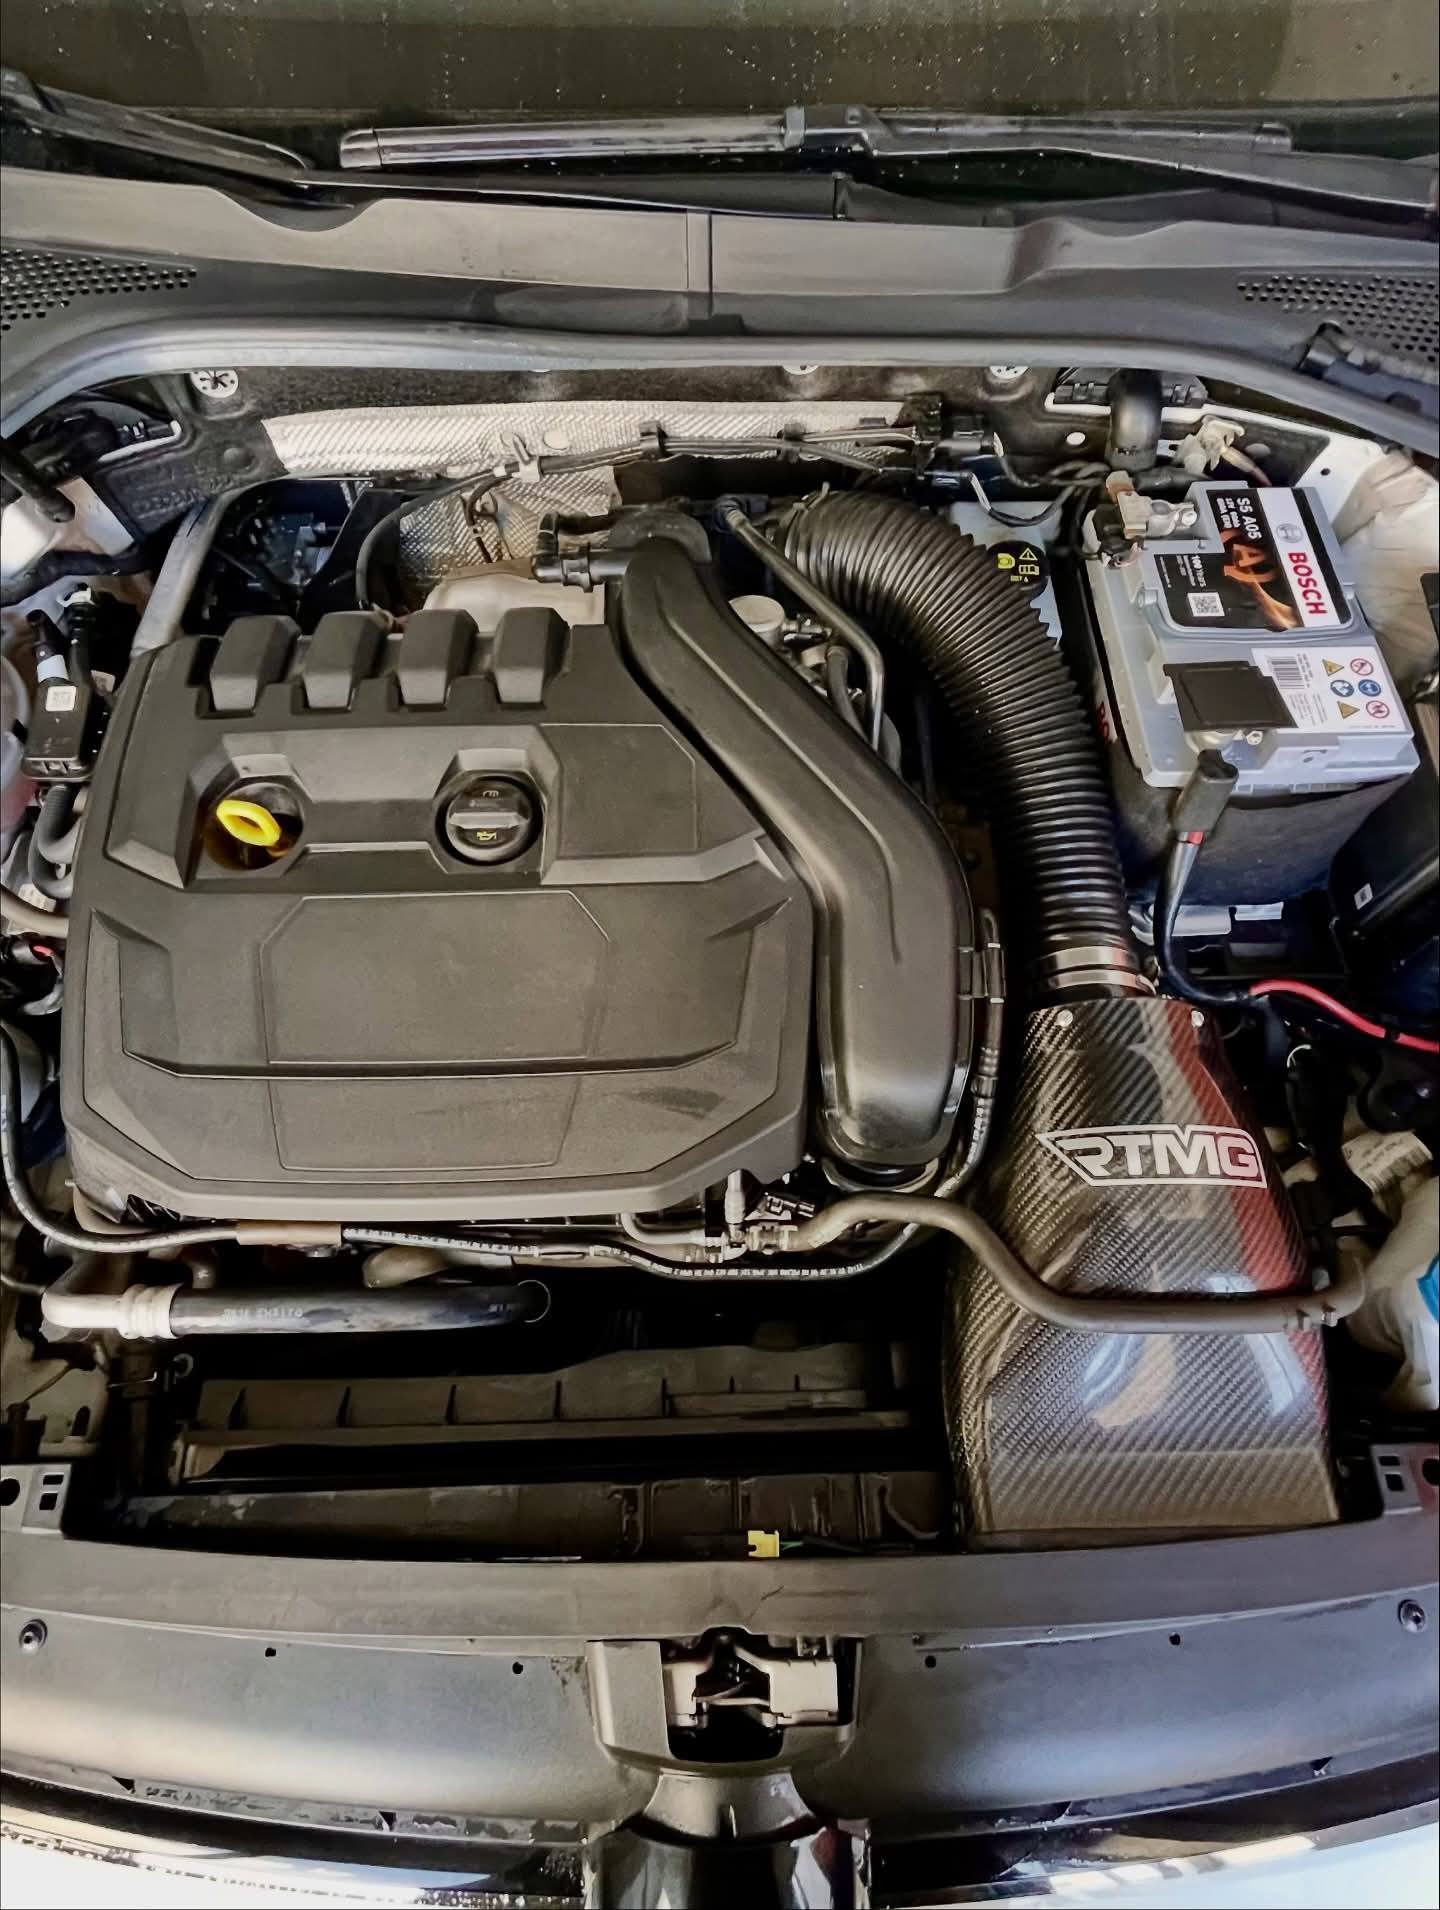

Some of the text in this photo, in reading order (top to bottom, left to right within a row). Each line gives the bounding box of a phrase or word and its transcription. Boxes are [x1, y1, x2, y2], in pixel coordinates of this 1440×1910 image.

[1237, 497, 1263, 540] S5 A05
[1287, 551, 1328, 614] BOSCH
[1055, 1133, 1259, 1177] RTMG
